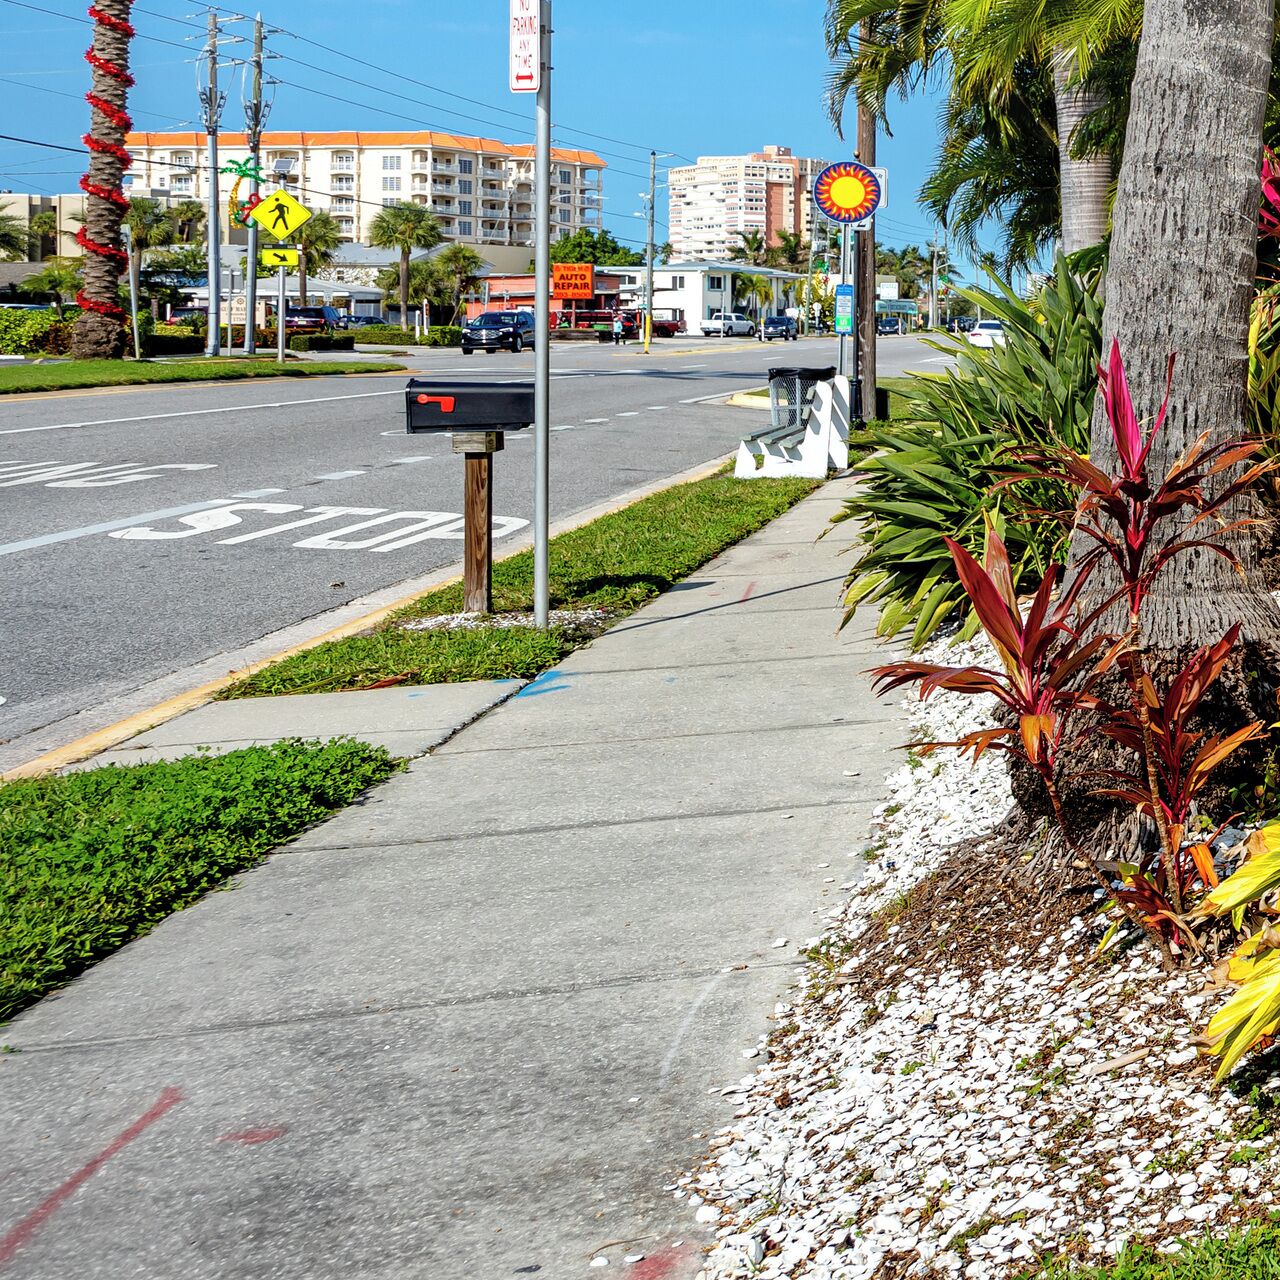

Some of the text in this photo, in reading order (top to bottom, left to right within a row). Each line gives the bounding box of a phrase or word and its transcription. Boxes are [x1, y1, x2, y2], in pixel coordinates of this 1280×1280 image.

[512, 15, 537, 35] PARKING
[519, 39, 530, 52] ANY
[516, 54, 532, 68] TIME
[559, 273, 587, 281] AUTO
[554, 282, 590, 290] REPAIR
[108, 503, 530, 552] STOP
